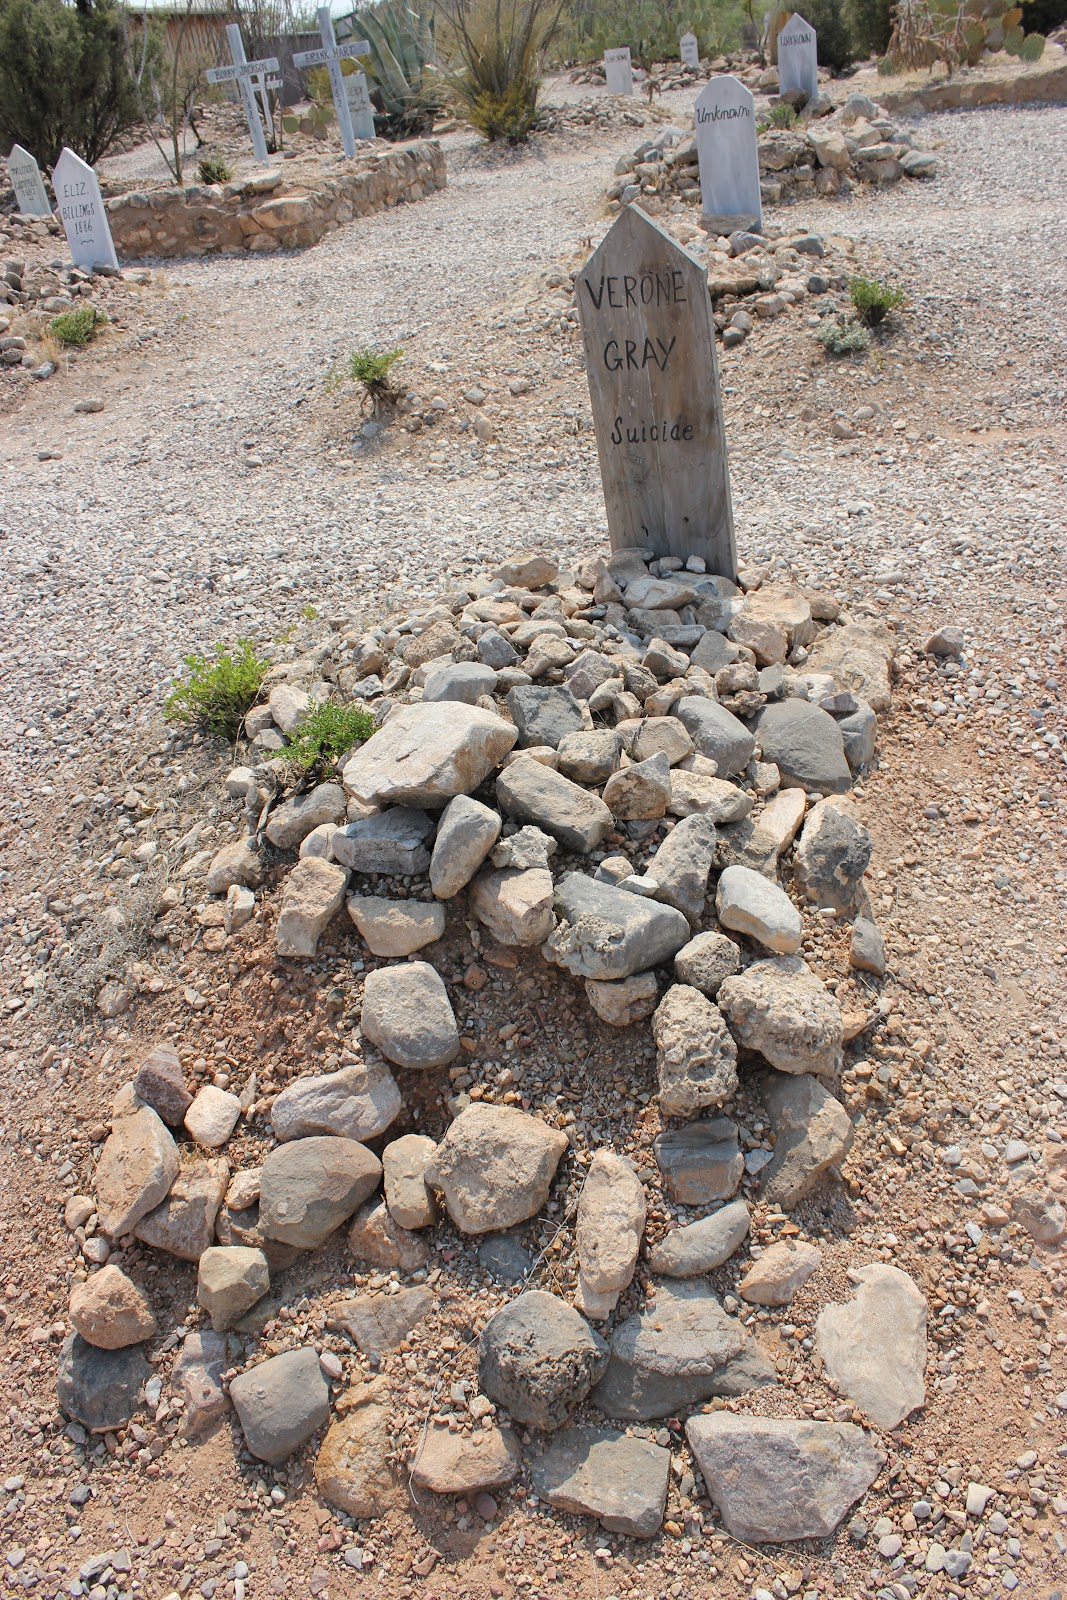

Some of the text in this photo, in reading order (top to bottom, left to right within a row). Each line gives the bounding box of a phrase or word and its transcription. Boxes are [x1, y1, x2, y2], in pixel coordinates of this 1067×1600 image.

[780, 33, 812, 46] UNKNOWN
[304, 45, 355, 63] FRANK HART
[214, 62, 268, 80] BOBBY JACKSON
[242, 83, 254, 120] 1882
[696, 105, 750, 124] Unknown
[63, 181, 90, 198] ELIZ.
[62, 202, 95, 220] BILLINGS
[74, 220, 93, 235] 1886
[584, 270, 687, 311] VERONE
[603, 335, 676, 372] GRAY
[610, 415, 693, 445] Suicide
